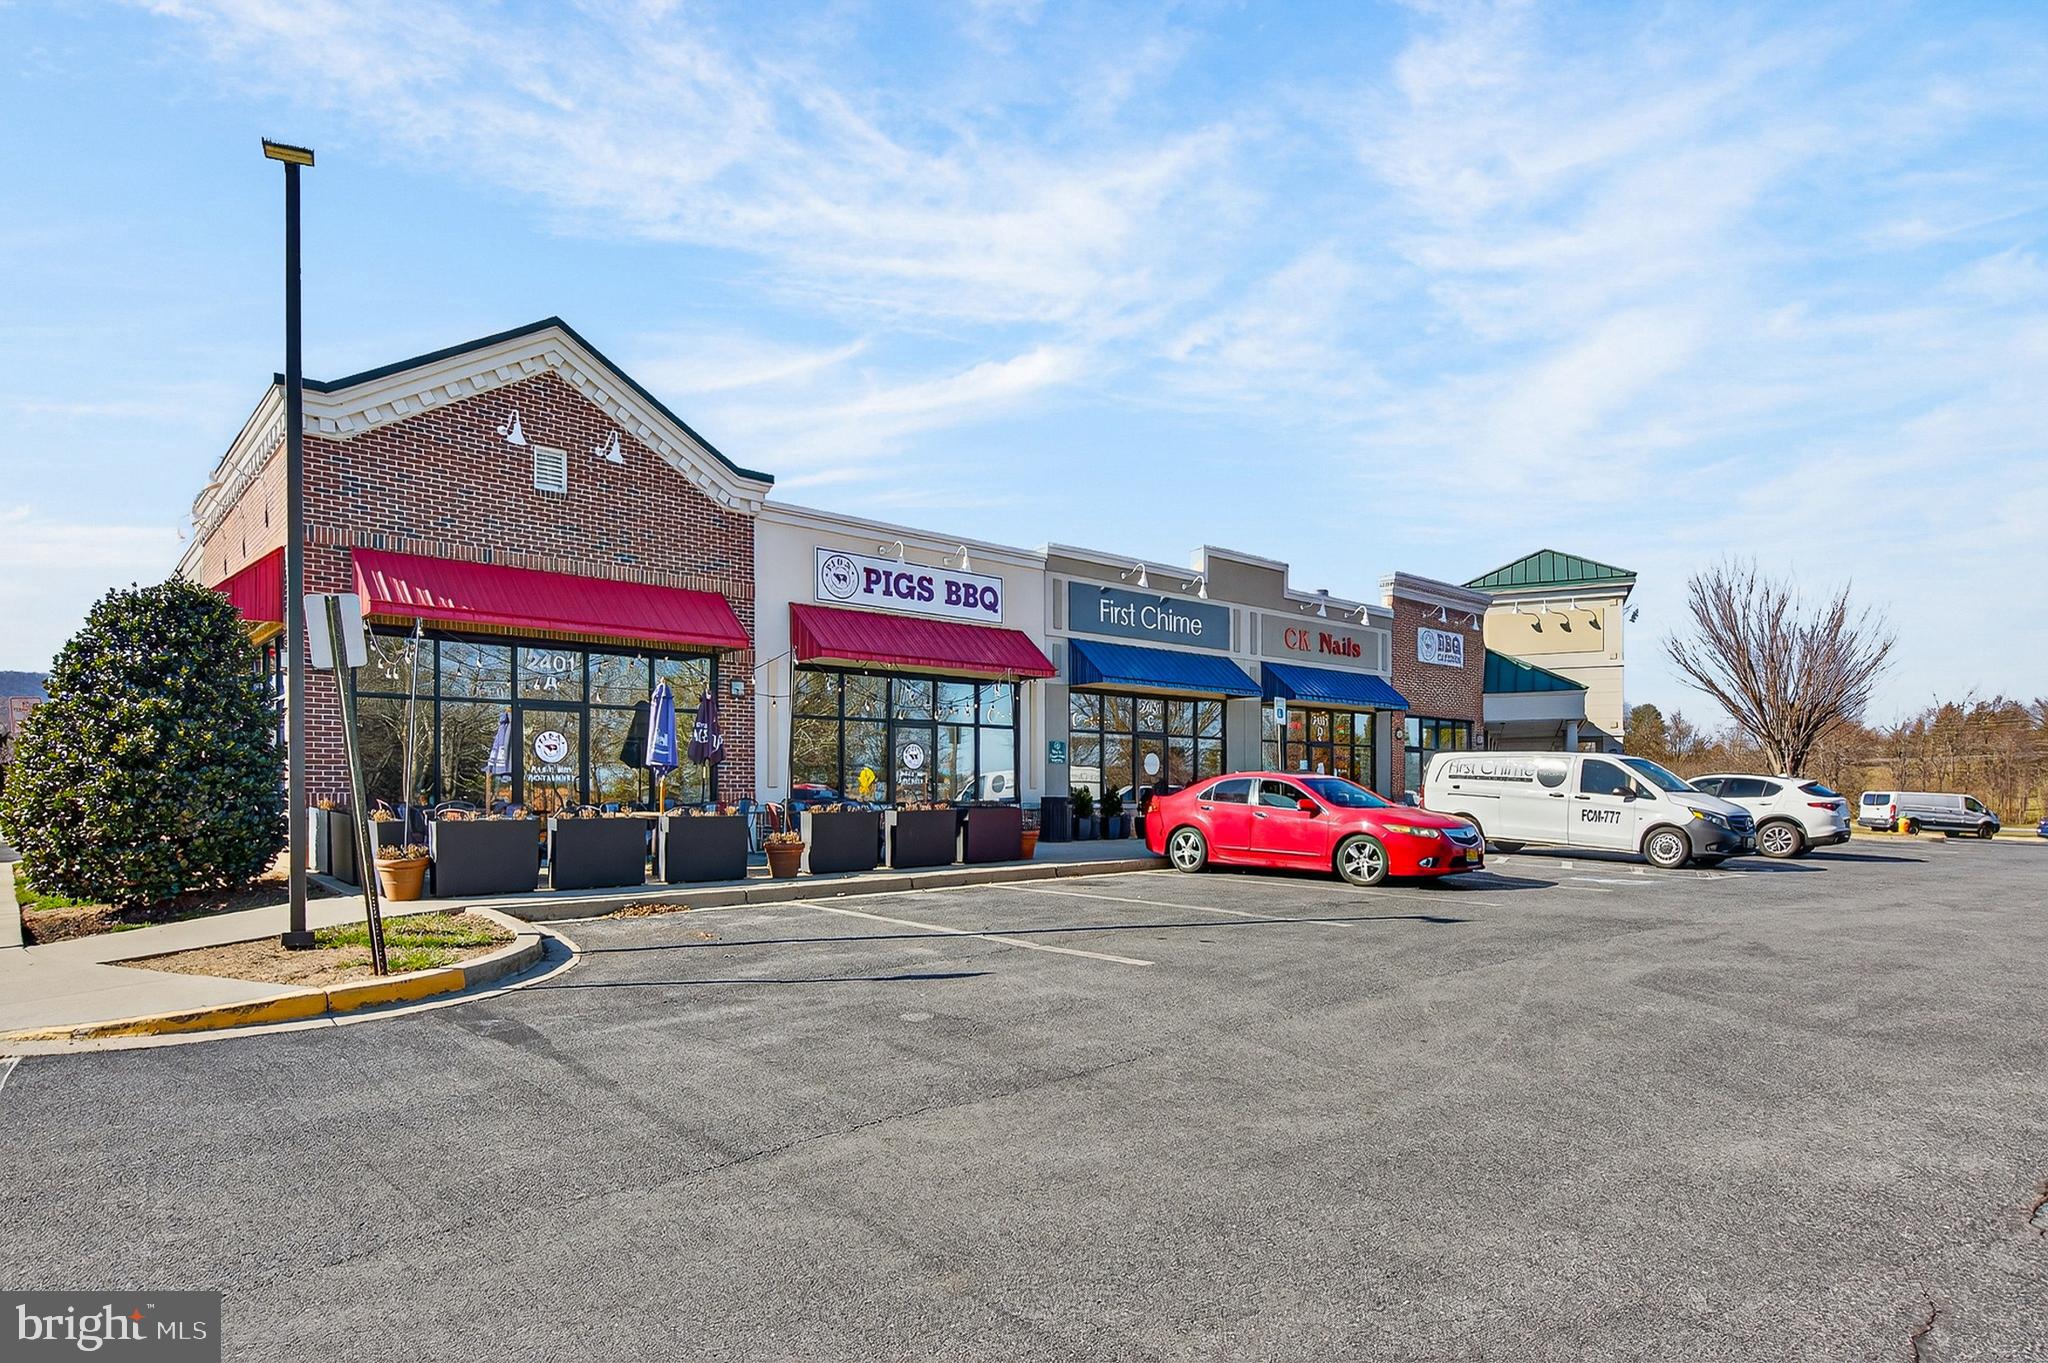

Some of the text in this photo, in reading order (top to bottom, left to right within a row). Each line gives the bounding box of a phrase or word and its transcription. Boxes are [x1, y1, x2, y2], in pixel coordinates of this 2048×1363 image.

[863, 567, 999, 613] PIGS BBQ
[1100, 599, 1203, 636] First Chime
[1284, 627, 1361, 658] CK Nails
[527, 653, 575, 672] 2401
[1581, 808, 1621, 824] FCM-777
